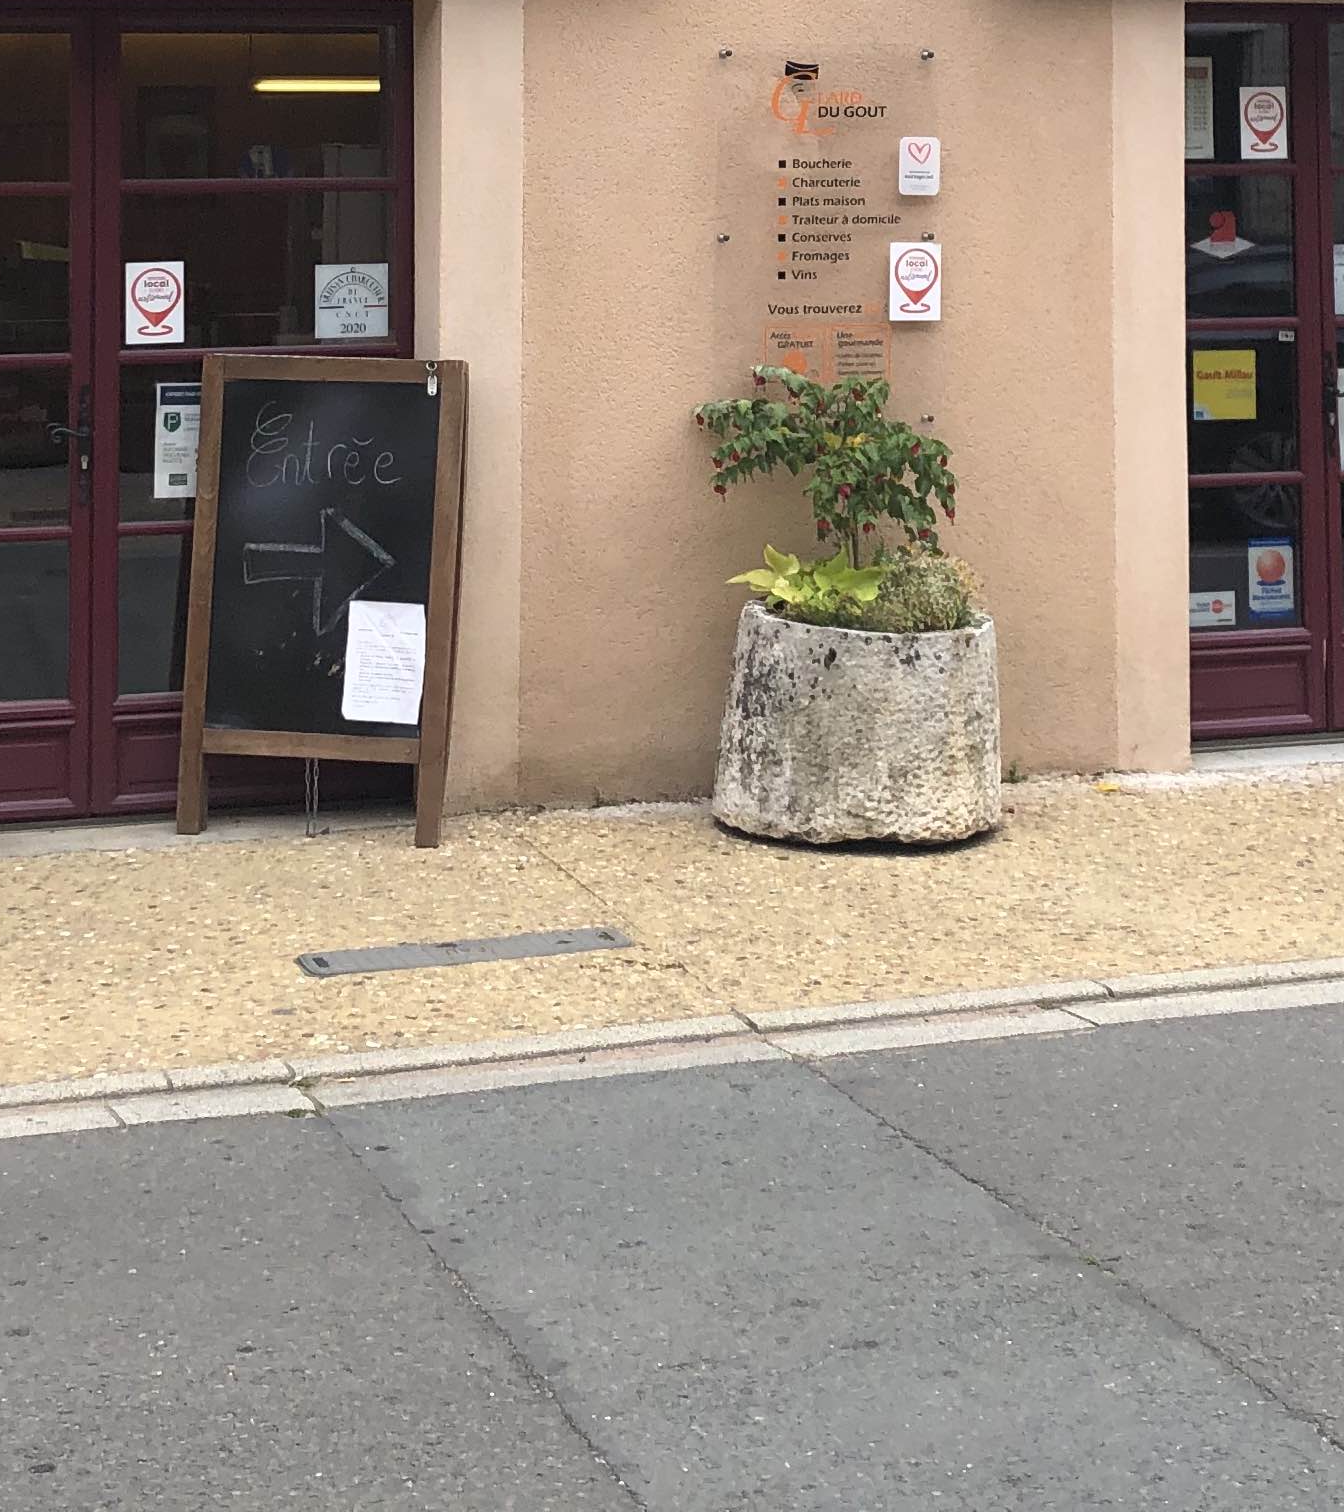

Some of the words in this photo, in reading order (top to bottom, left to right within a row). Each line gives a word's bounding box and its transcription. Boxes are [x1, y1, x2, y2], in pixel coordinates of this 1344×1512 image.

[818, 106, 840, 118] DU
[844, 106, 887, 118] GOUT
[792, 158, 853, 169] Boucherie
[792, 177, 861, 188] Charcuterie
[792, 196, 820, 207] Plats
[823, 196, 865, 206] maison
[792, 215, 838, 225] Traiteur
[842, 214, 849, 225] à
[852, 214, 901, 225] domicile
[792, 232, 852, 243] Conserves
[792, 251, 850, 263] Fromages
[905, 259, 928, 268] local
[792, 270, 817, 280] Vins
[144, 279, 169, 288] local
[768, 304, 799, 315] Vous
[803, 304, 862, 315] trouverez
[340, 322, 367, 334] 2020
